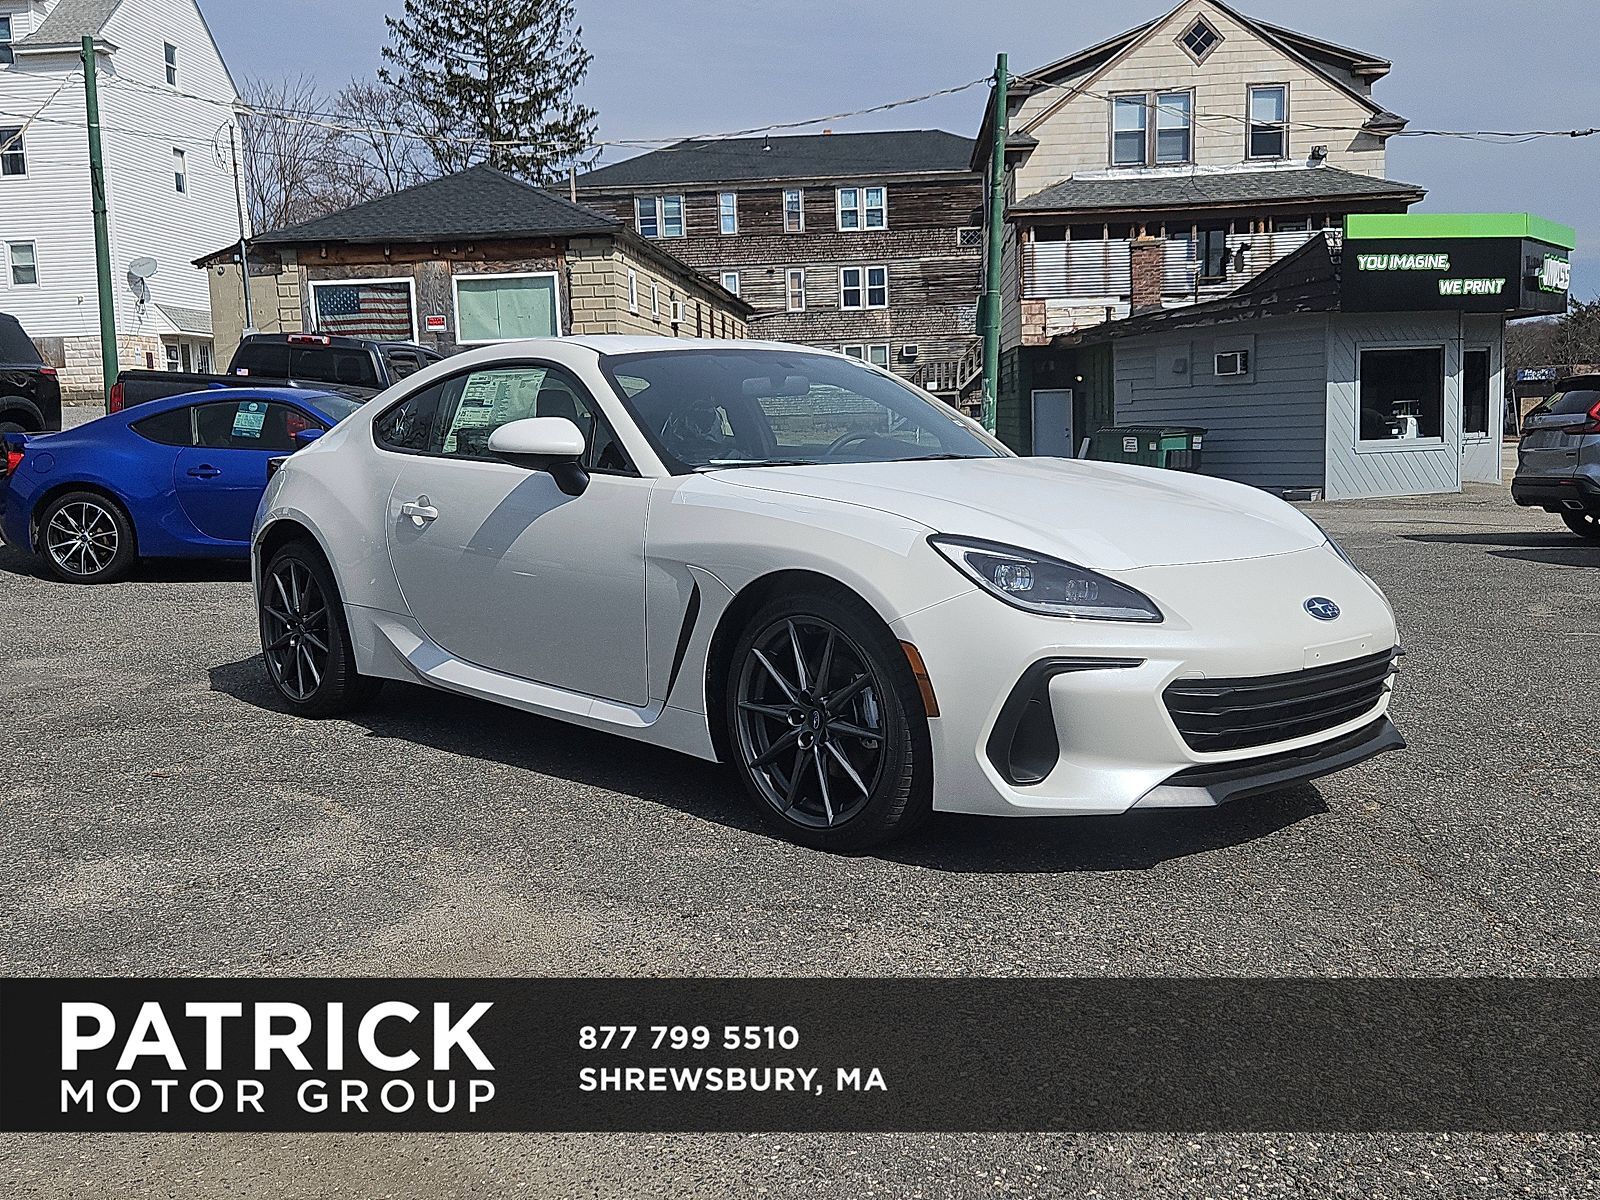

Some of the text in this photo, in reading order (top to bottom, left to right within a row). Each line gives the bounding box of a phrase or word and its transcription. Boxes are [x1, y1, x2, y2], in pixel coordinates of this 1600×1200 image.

[1357, 254, 1450, 271] YOU IMAGINE,
[1439, 279, 1505, 295] WE PRINT
